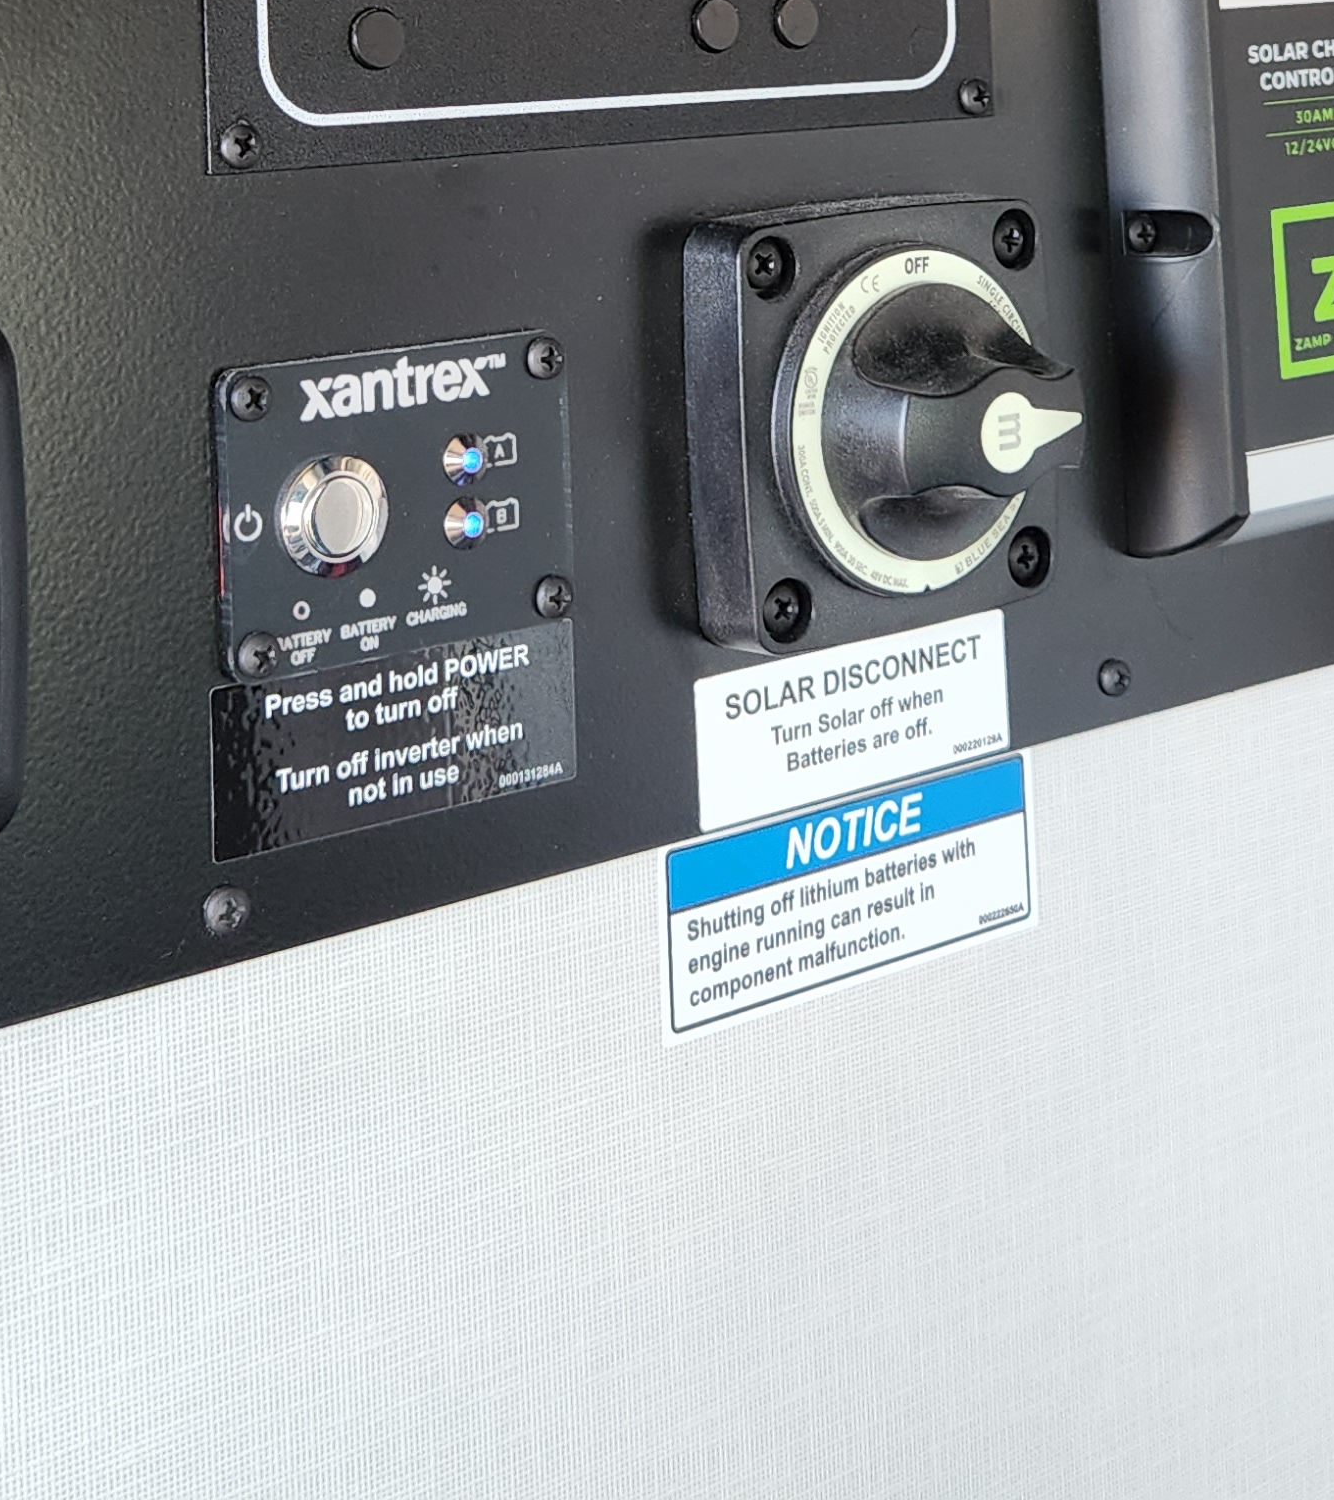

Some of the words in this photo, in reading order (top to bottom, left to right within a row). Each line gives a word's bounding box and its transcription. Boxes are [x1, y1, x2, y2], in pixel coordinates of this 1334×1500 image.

[1247, 40, 1308, 65] SOLAR
[904, 256, 930, 274] OFF
[817, 301, 846, 344] IGNITION
[976, 275, 1004, 306] SINGLE
[1002, 303, 1025, 337] CIRCU
[823, 305, 856, 355] PROTECTED
[1294, 333, 1331, 352] ZAMP
[494, 443, 505, 459] A
[496, 507, 507, 525] B
[965, 537, 993, 570] BLUE
[992, 515, 1011, 540] SEA
[340, 616, 397, 640] BATTERY
[406, 601, 467, 626] CHARGING
[290, 648, 316, 666] OFF
[360, 635, 380, 652] ON
[265, 687, 333, 719] Press
[339, 674, 382, 702] and
[389, 663, 439, 693] hold
[444, 644, 530, 682] POWER
[725, 675, 816, 721] SOLAR
[823, 634, 981, 697] DISCONNECT
[345, 707, 369, 732] to
[375, 698, 422, 726] turn
[428, 685, 459, 711] off
[771, 719, 812, 746] Turn
[818, 706, 864, 734] Solar
[870, 695, 894, 720] off
[897, 686, 944, 713] when
[276, 764, 329, 794] Turn
[336, 750, 369, 780] off
[374, 735, 460, 771] inverter
[466, 721, 524, 752] when
[787, 734, 867, 773] Batteries
[872, 729, 900, 750] are
[904, 716, 933, 741] off.
[348, 780, 386, 808] not
[393, 771, 414, 798] in
[419, 763, 460, 791] use
[498, 762, 564, 789] 000131284A
[786, 791, 924, 870] NOTICE
[686, 901, 765, 941] Shutting
[771, 888, 795, 917] off
[799, 867, 859, 905] lithium
[865, 851, 938, 888] batteries
[942, 837, 976, 866] with
[688, 942, 750, 975] engine
[756, 918, 826, 955] running
[831, 905, 861, 931] can
[867, 889, 916, 921] result
[920, 883, 936, 904] in
[689, 962, 793, 1007] component
[798, 927, 906, 971] malfunction.
